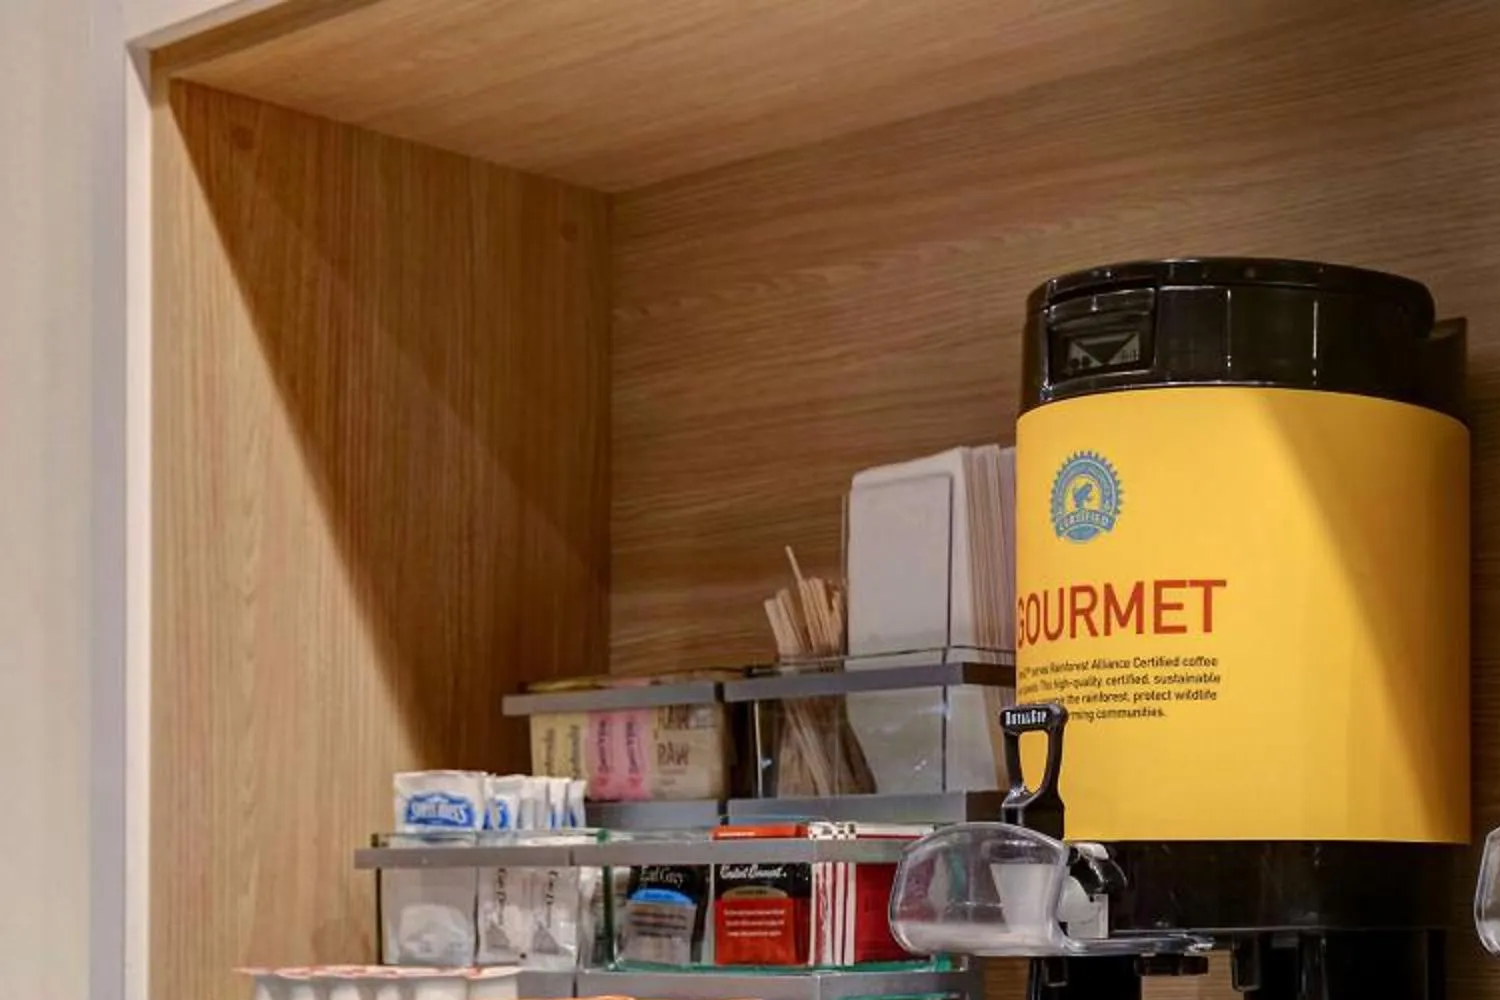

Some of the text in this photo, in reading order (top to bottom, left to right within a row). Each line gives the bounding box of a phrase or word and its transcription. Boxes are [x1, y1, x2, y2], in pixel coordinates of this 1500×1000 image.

[1017, 579, 1228, 649] GOURMET
[1133, 656, 1180, 669] Certified
[1182, 656, 1218, 668] coffee
[1153, 672, 1221, 685] sustainable
[1133, 690, 1171, 704] protect
[1174, 688, 1217, 701] wildlife
